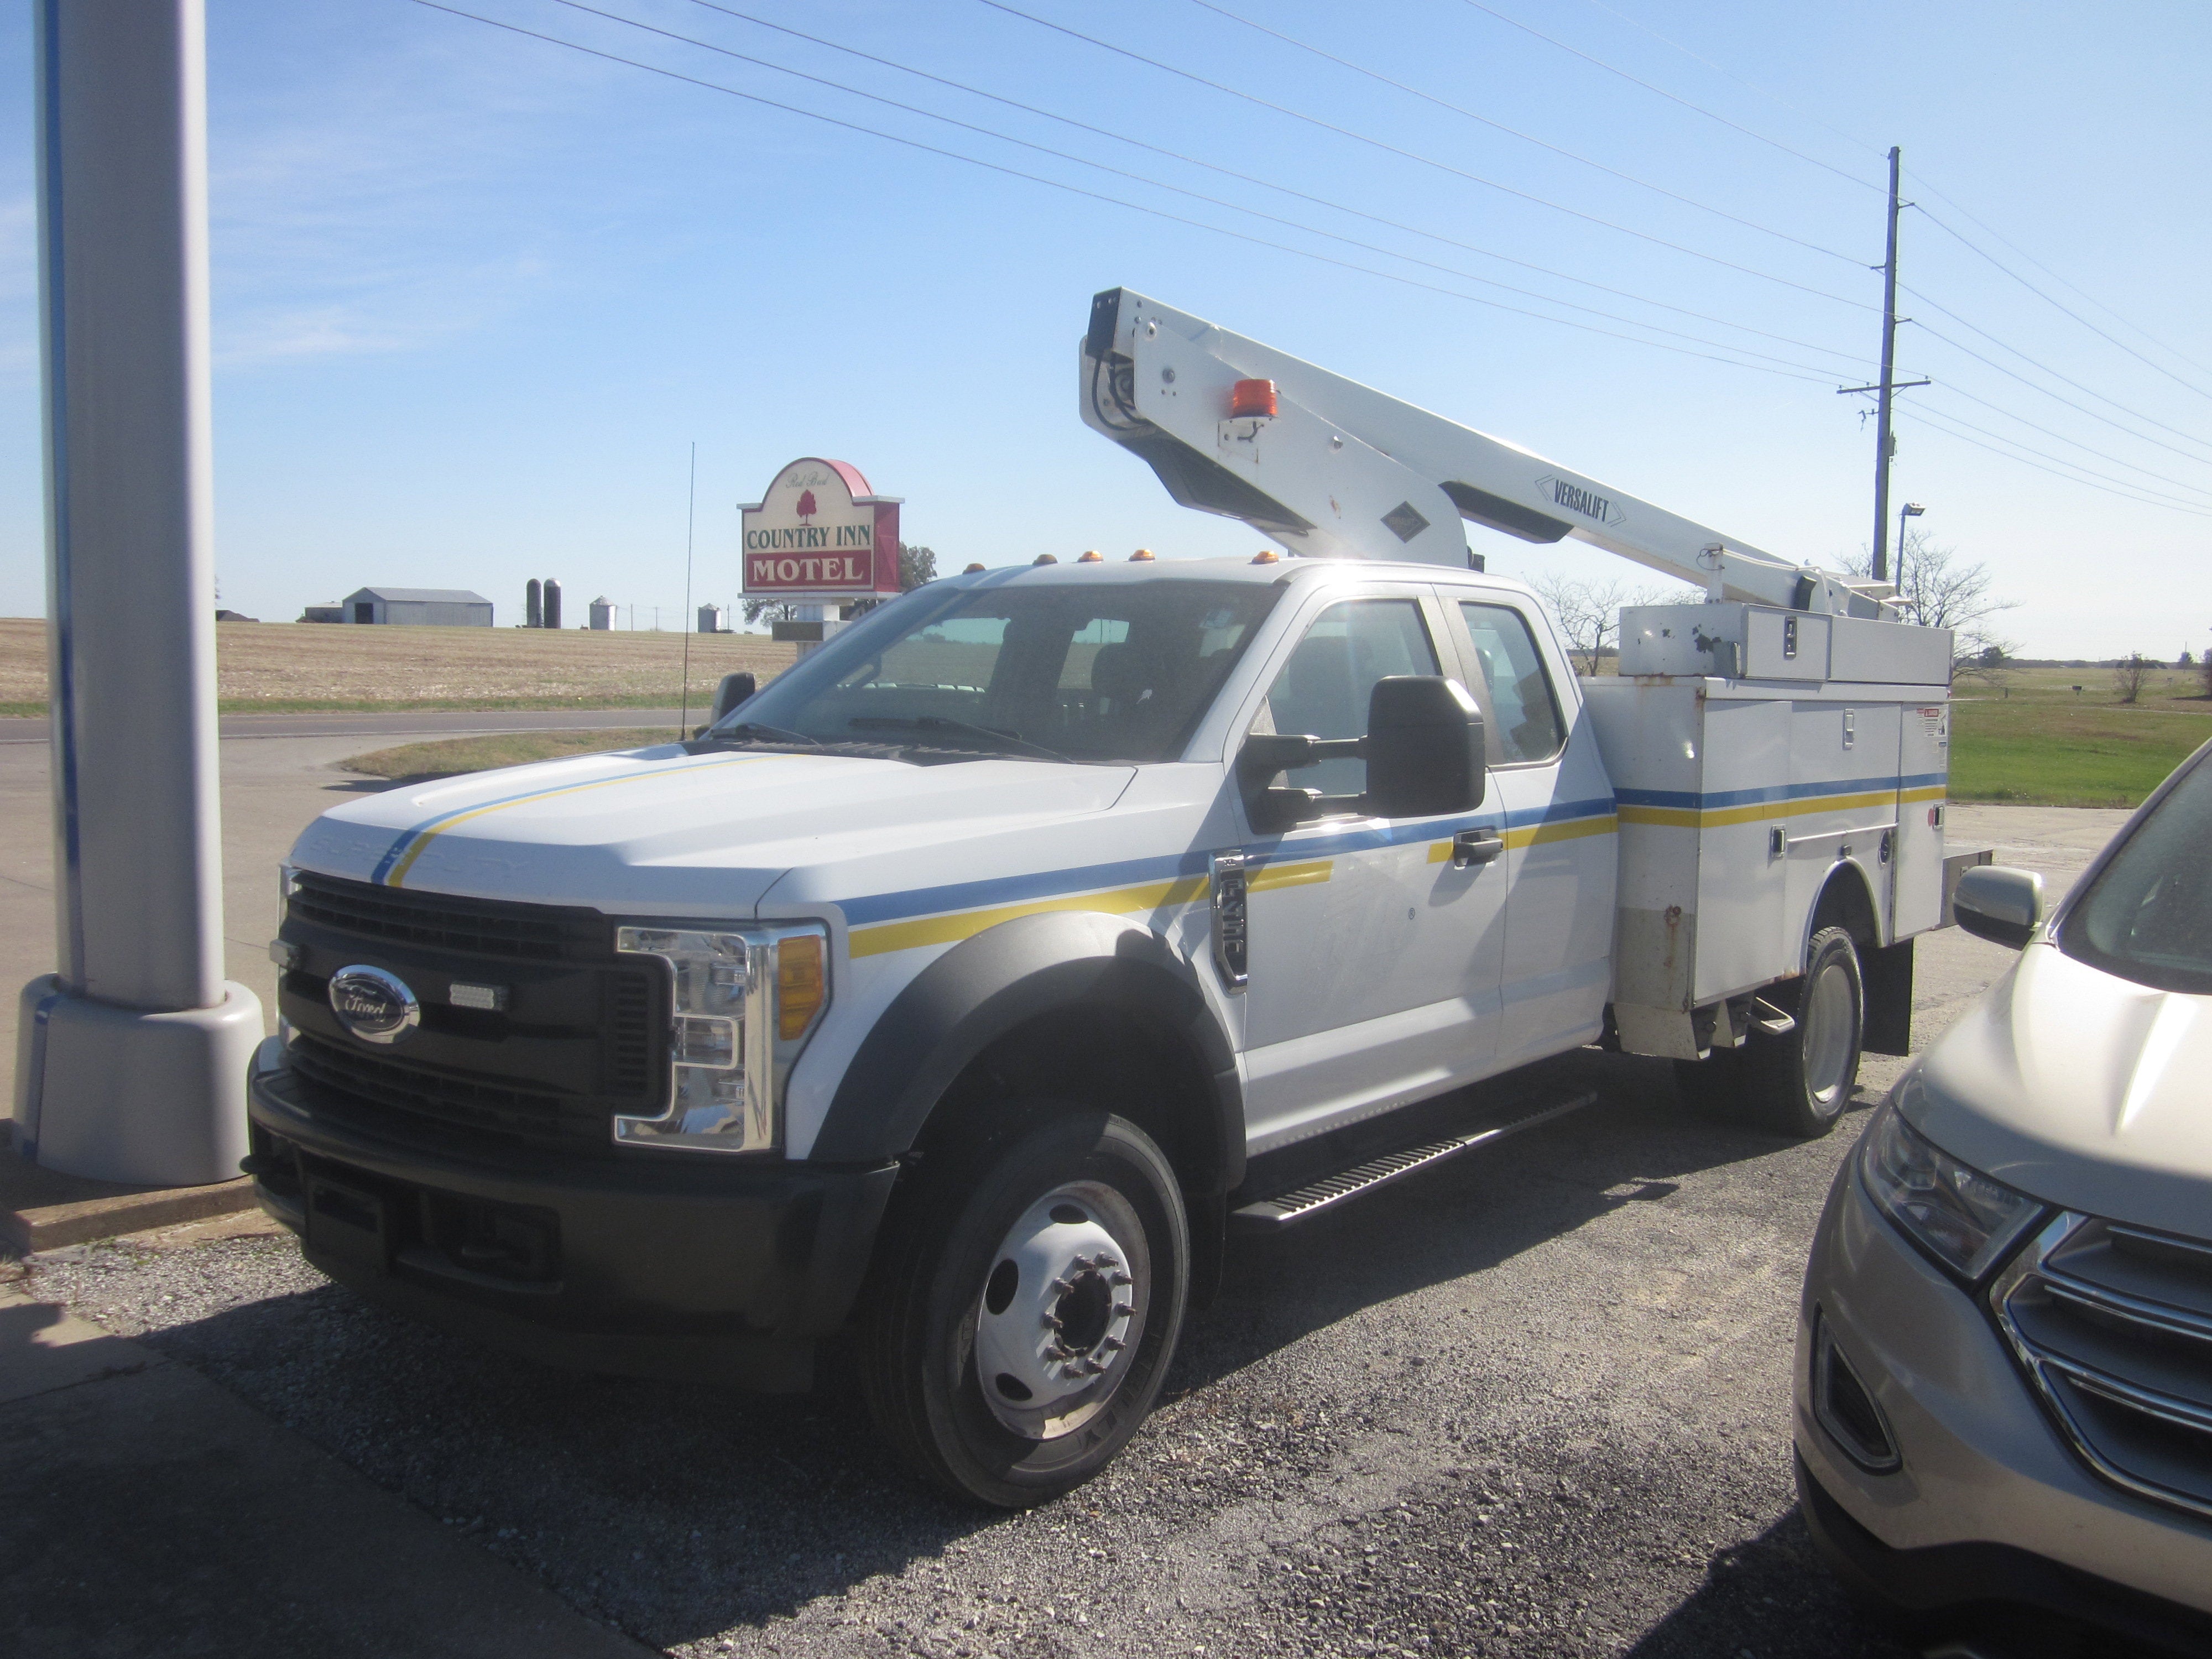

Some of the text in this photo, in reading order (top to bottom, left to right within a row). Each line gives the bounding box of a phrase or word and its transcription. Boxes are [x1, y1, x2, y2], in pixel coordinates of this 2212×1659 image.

[786, 473, 806, 488] Red
[1554, 479, 1609, 521] VERSALIFT
[747, 525, 870, 549] COUNTRY INN
[752, 557, 864, 581] MOTEL
[345, 986, 387, 1023] Ford
